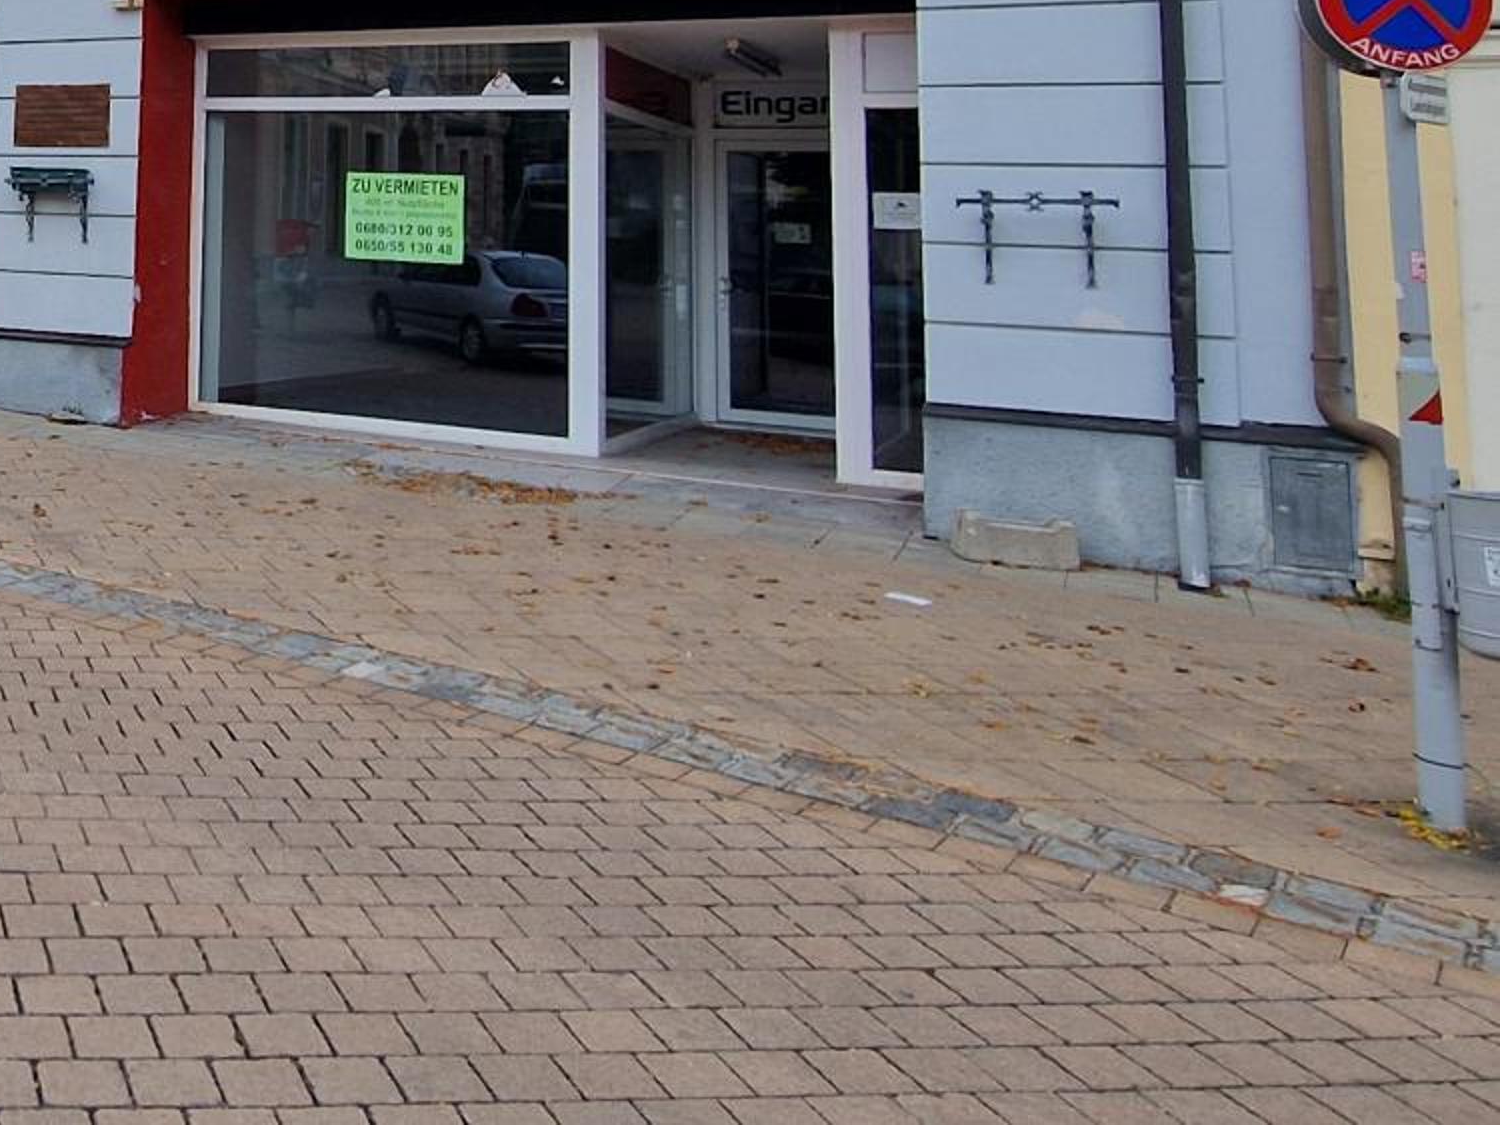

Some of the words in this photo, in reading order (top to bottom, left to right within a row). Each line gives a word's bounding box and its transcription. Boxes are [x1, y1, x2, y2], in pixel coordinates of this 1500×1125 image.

[1349, 37, 1461, 68] ANFANG
[352, 178, 371, 194] ZU
[375, 179, 459, 196] VERMIETEN
